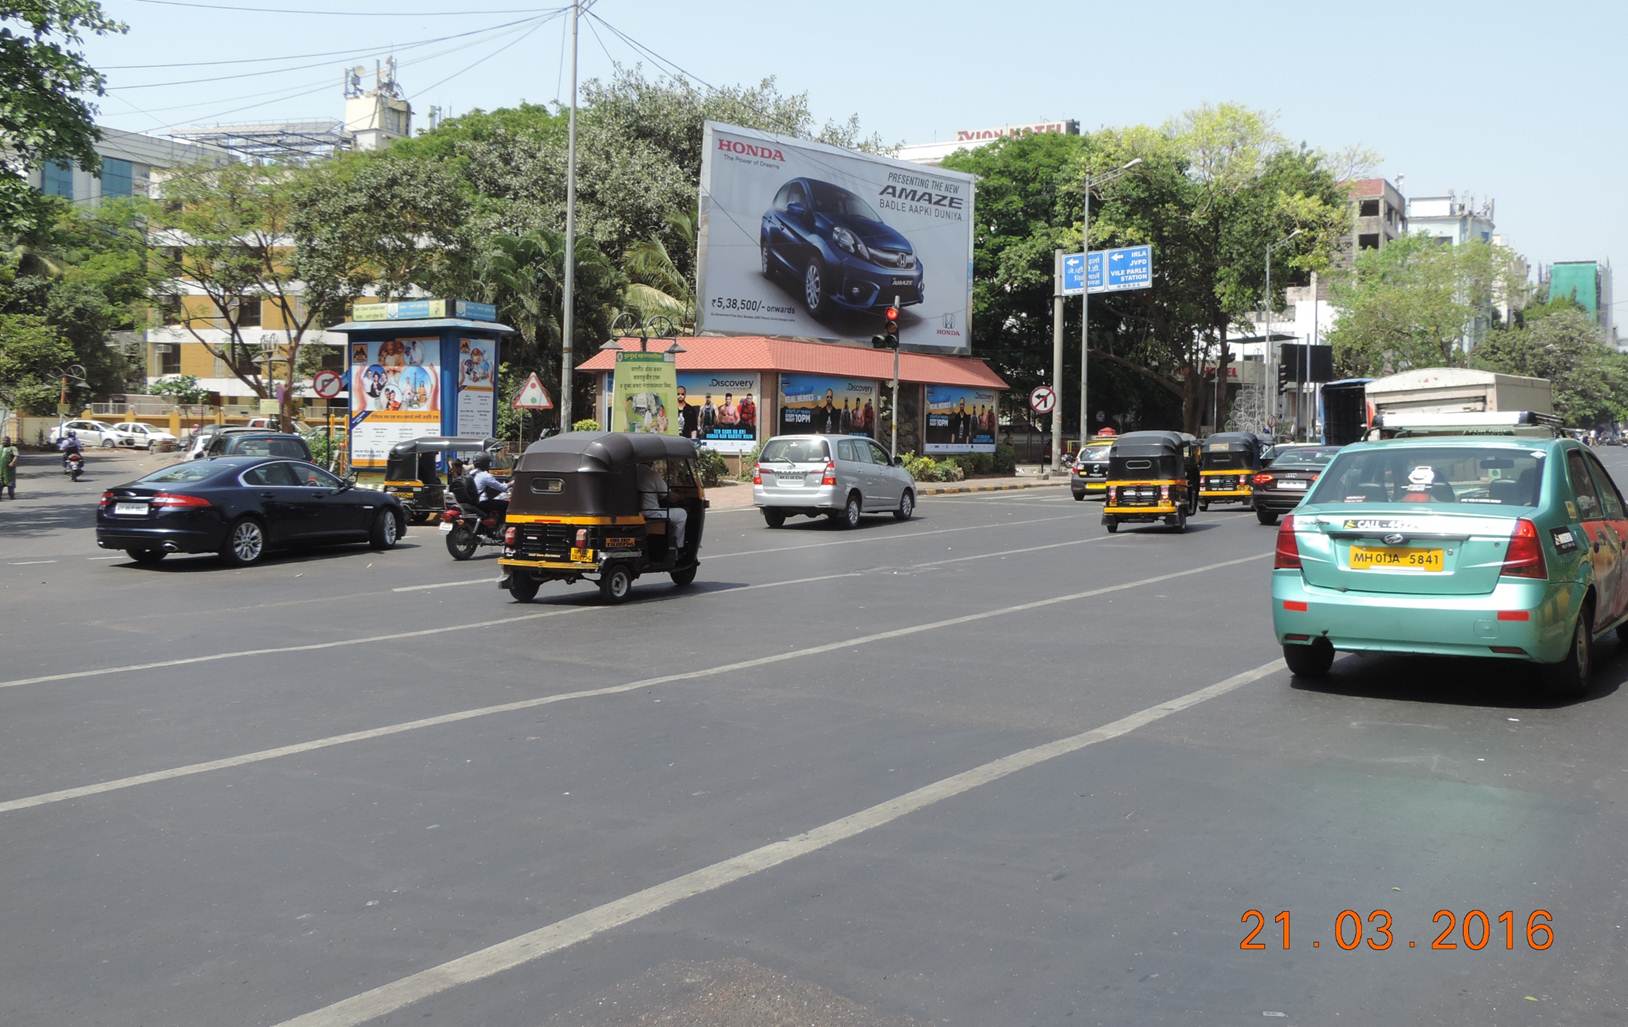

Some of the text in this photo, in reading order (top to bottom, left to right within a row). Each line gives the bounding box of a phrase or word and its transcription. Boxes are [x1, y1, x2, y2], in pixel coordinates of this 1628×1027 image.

[718, 139, 785, 162] HONDA
[888, 172, 960, 194] PRESENTING THE NEW
[878, 185, 964, 210] AMAZE
[880, 199, 962, 221] BADLE AAPKI DUNIYA
[766, 305, 795, 314] onwards
[936, 329, 960, 337] HONDA
[795, 414, 811, 423] 10PM
[1357, 520, 1380, 529] CALL
[1353, 552, 1373, 563] MH
[1409, 555, 1439, 565] 5841
